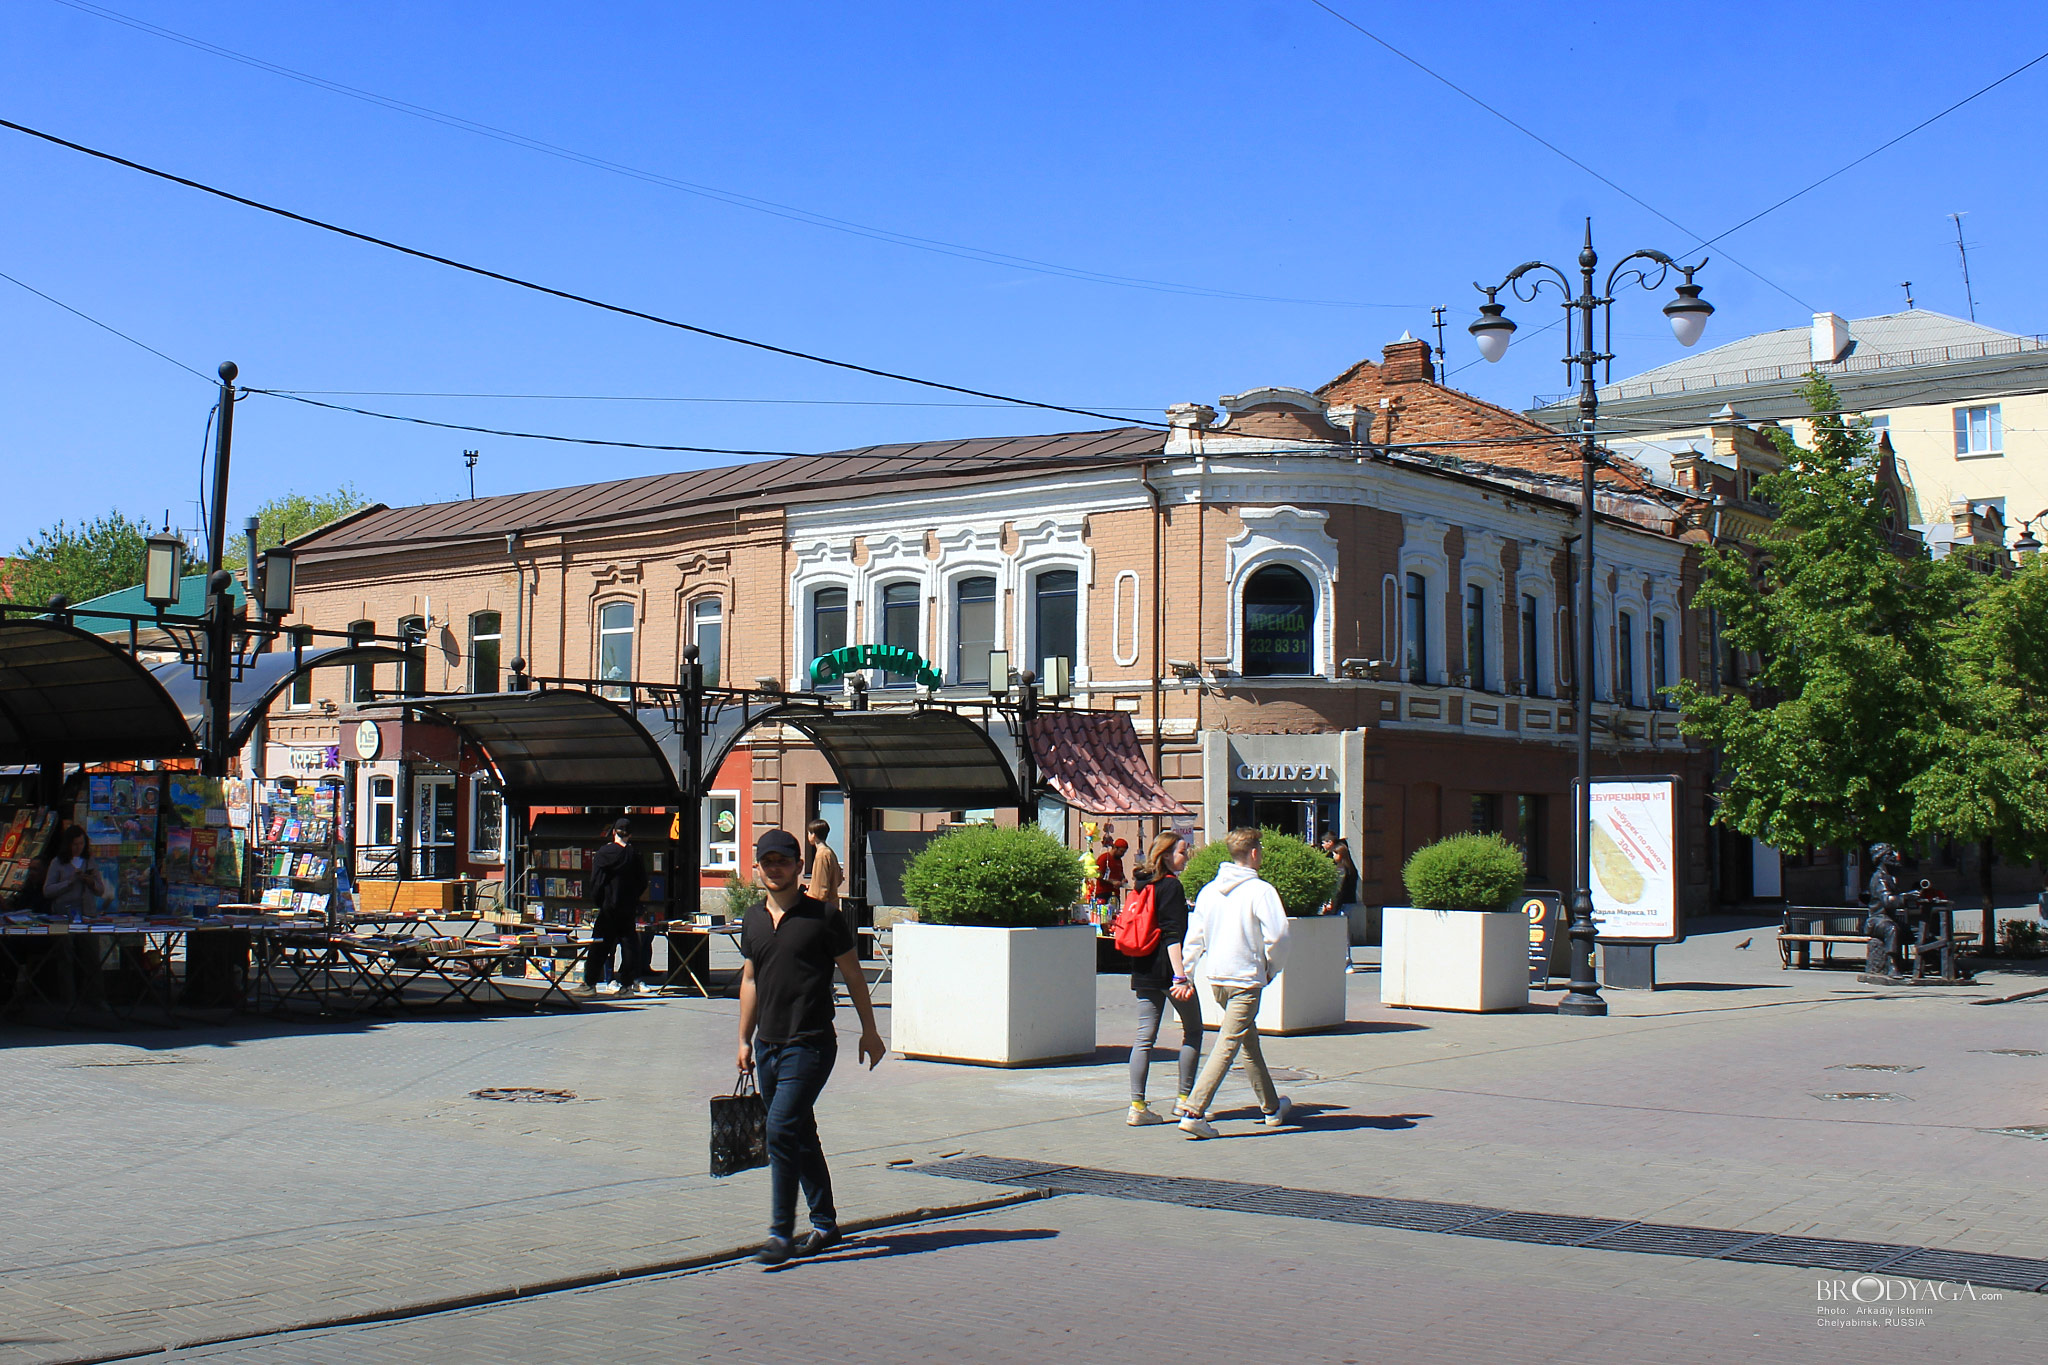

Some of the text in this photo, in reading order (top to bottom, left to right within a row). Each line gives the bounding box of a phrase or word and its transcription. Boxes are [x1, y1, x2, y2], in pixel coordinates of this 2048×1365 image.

[1250, 613, 1305, 632] АРЕНДА
[1250, 638, 1306, 653] 232 83 31
[1236, 763, 1331, 780] СИЛУЭТ
[1590, 793, 1650, 802] ЕБУРЕЧНАЯ
